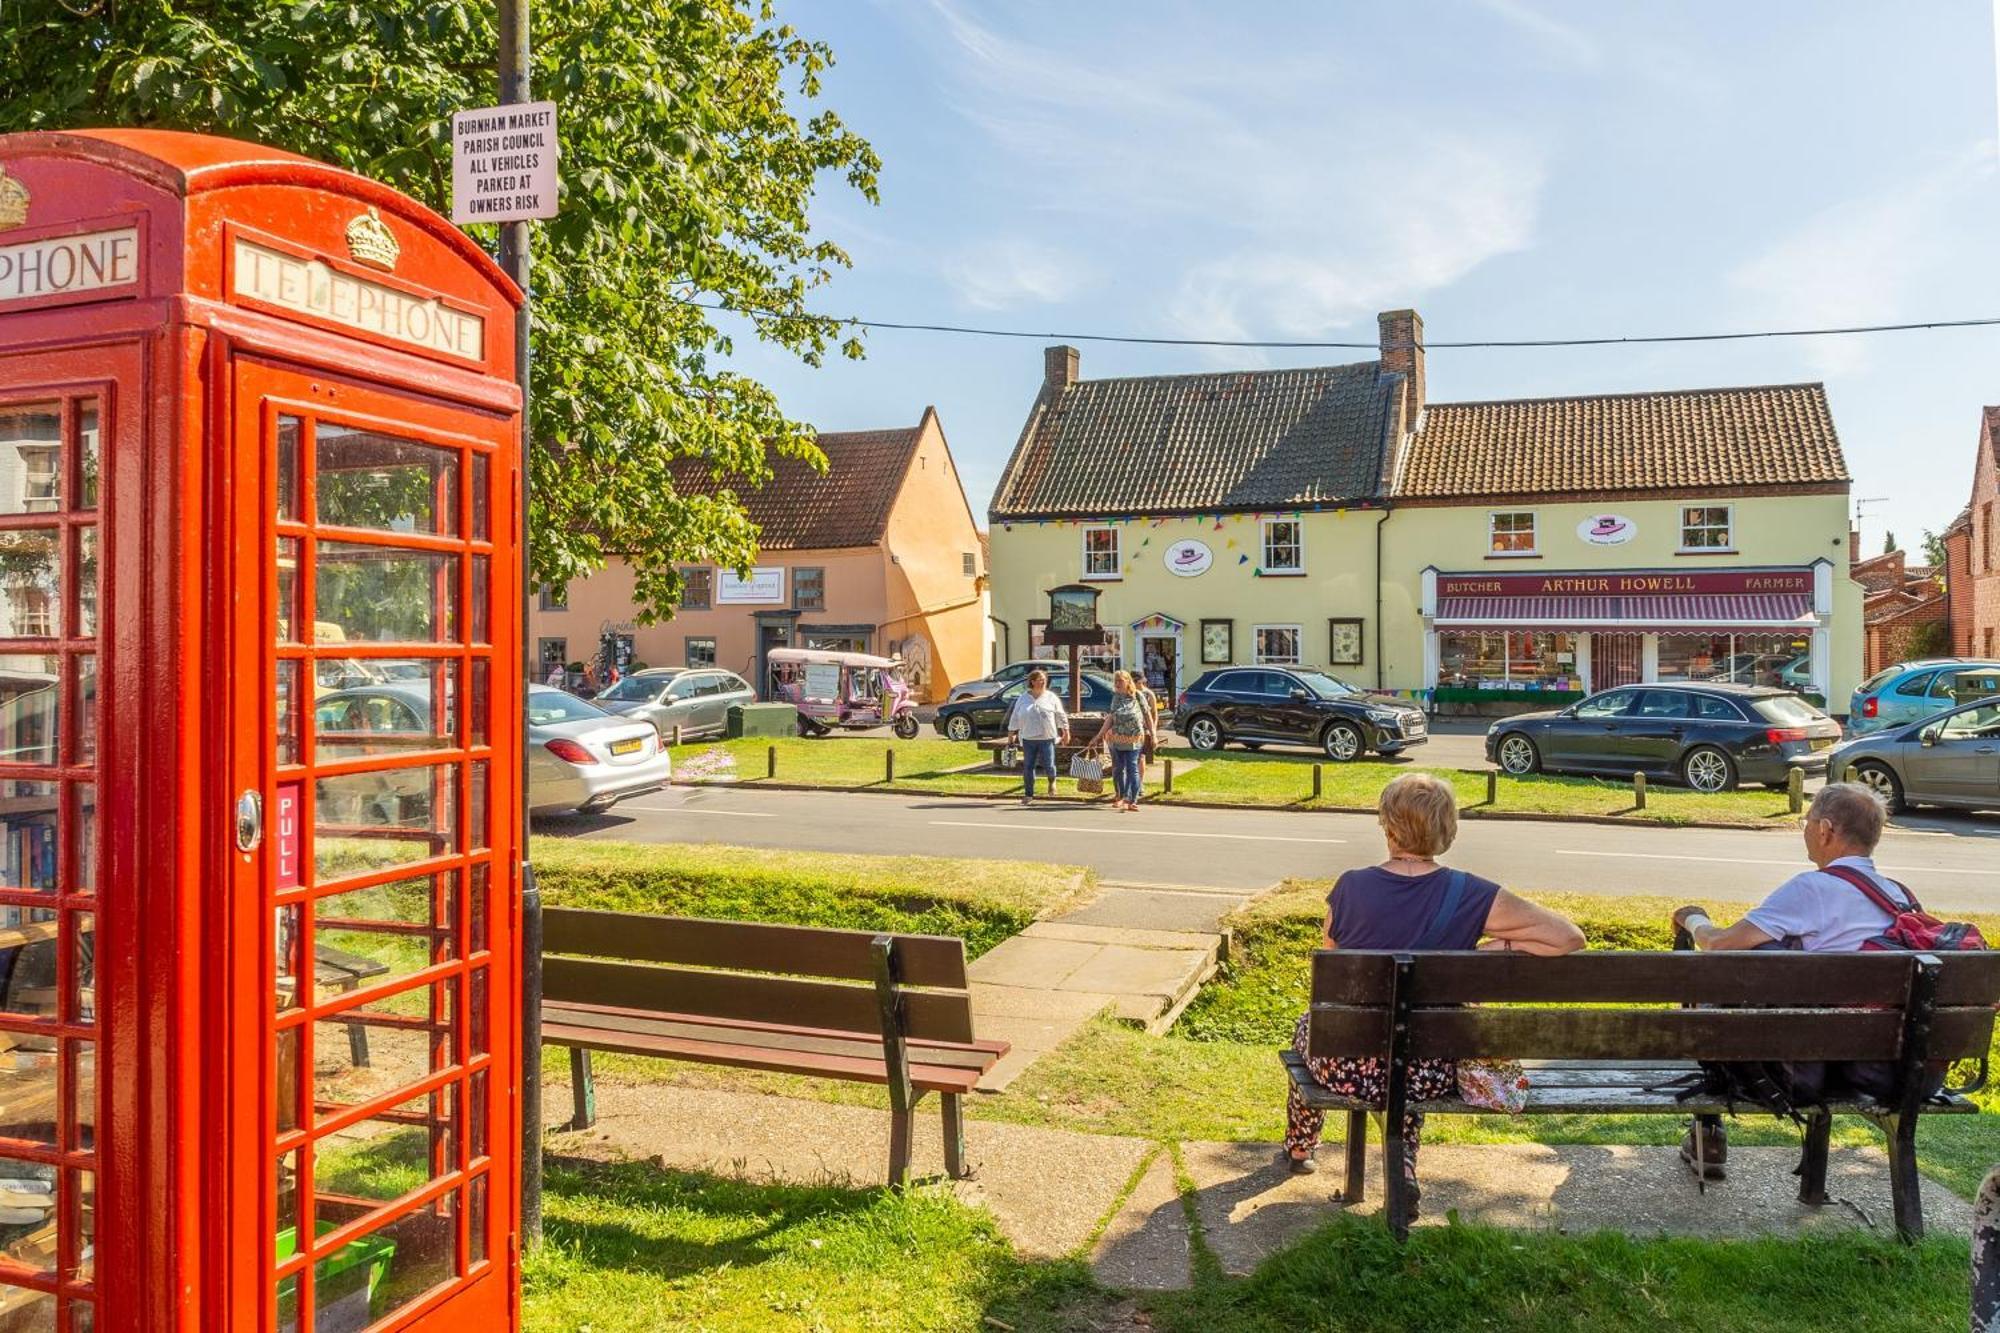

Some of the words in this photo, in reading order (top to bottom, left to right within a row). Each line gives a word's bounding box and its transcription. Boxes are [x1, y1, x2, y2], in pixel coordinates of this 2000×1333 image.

[458, 117, 506, 135] BURNHAM
[509, 112, 550, 130] MARKET
[463, 137, 499, 154] PARISH
[502, 133, 545, 151] COUNCIL
[470, 158, 488, 174] ALL
[491, 154, 539, 171] VEHICLES
[476, 176, 516, 193] PARKED
[519, 175, 532, 190] AT
[469, 197, 512, 214] OWNERS
[515, 194, 540, 210] RISK
[244, 250, 474, 355] TELEPHONE
[1446, 582, 1502, 593] BUTCHER
[1542, 578, 1610, 592] ARTHUR
[1620, 577, 1697, 591] HOWELL
[1745, 577, 1805, 590] FARMER
[280, 798, 293, 876] PULL
